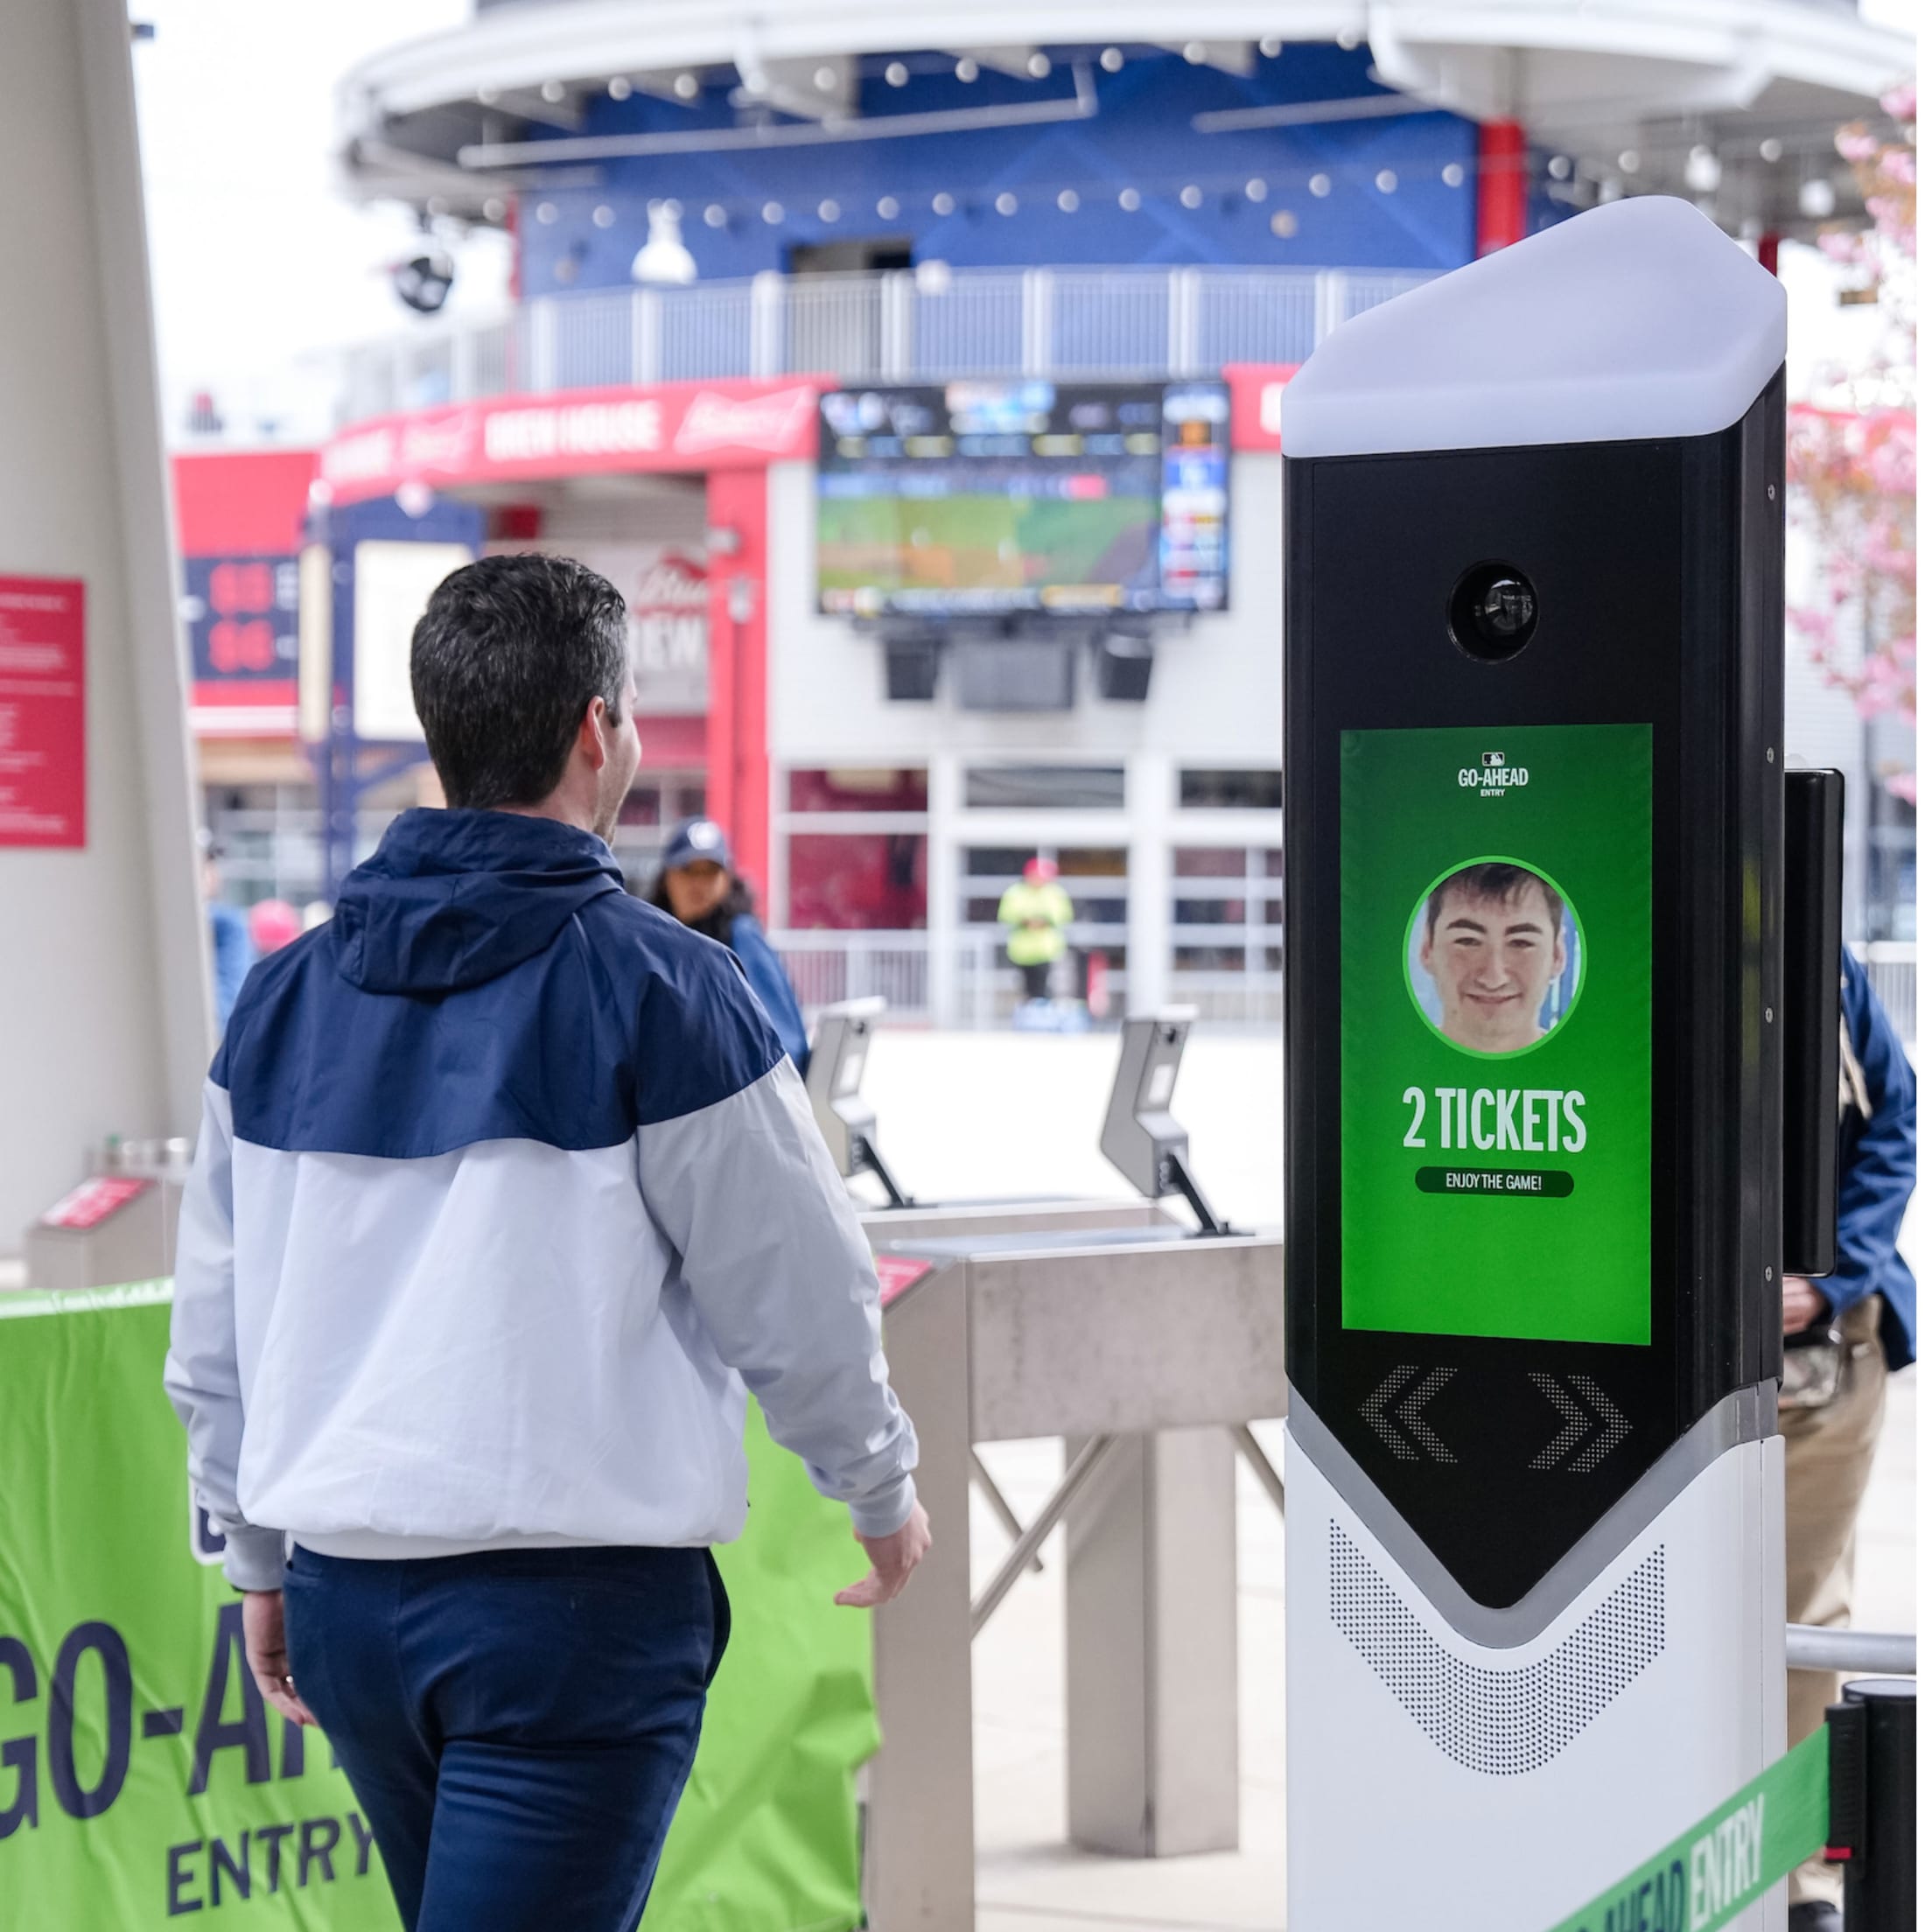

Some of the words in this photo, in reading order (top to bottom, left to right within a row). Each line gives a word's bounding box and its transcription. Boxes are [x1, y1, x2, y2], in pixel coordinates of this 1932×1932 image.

[1458, 767, 1529, 787] GO-AHEAD
[1480, 788, 1505, 797] ENTRY
[1403, 1087, 1426, 1148] 2
[1435, 1088, 1587, 1152] TICKETS
[1446, 1172, 1480, 1188] ENJOY
[1481, 1173, 1503, 1189] THE
[1506, 1175, 1542, 1191] GAME!
[0, 1601, 343, 1838] GO-A
[167, 1811, 374, 1916] ENTRY
[1690, 1792, 1765, 1932] ENTRY
